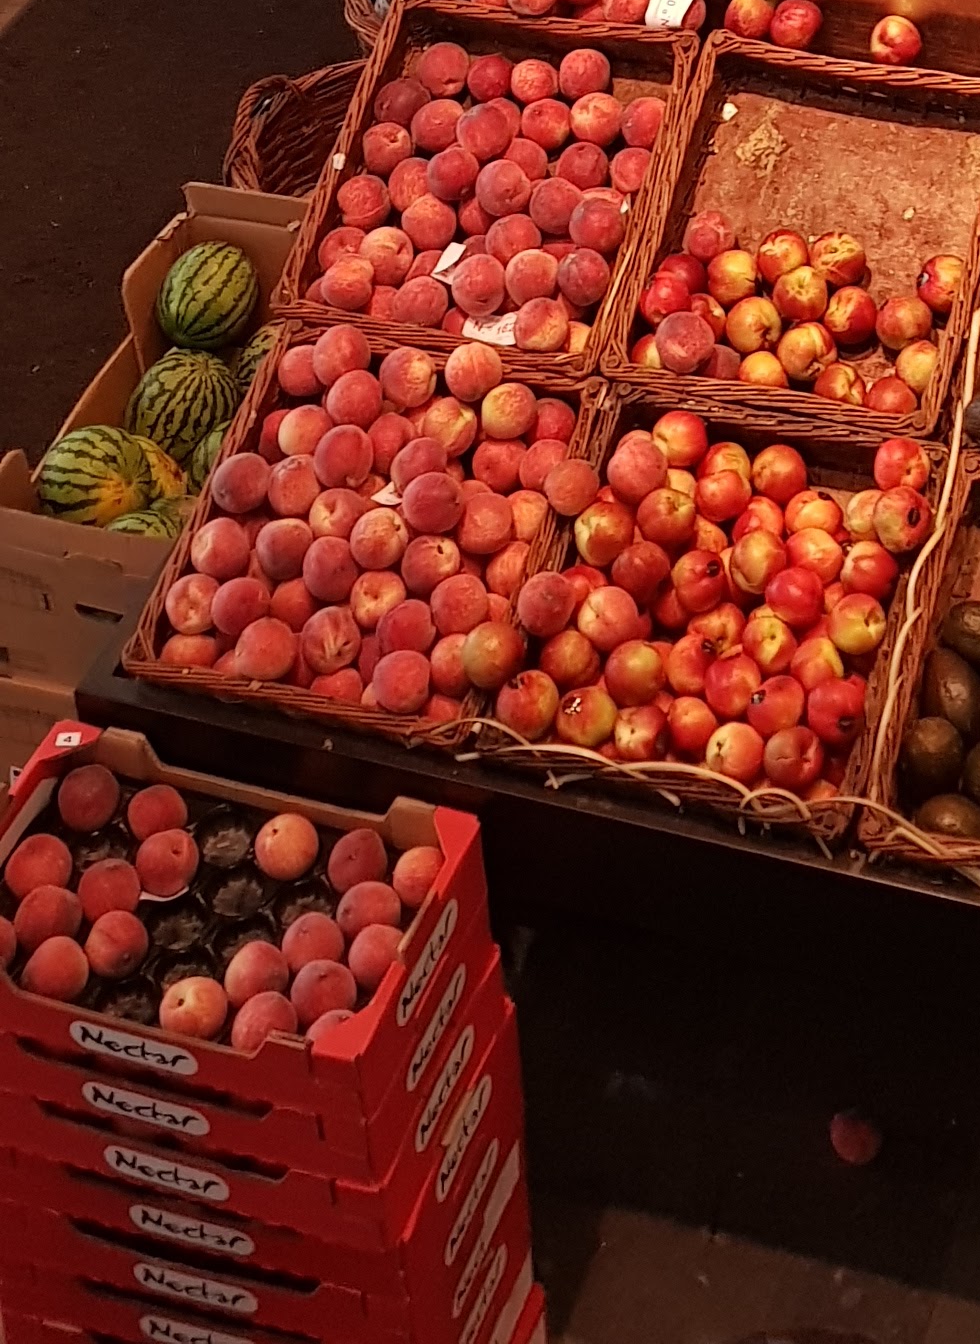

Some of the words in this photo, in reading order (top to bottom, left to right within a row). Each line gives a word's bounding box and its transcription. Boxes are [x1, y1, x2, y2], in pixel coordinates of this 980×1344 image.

[63, 735, 72, 743] 4
[80, 1024, 188, 1068] Nectar
[91, 1085, 200, 1128] Nectar
[114, 1149, 220, 1194] Nectar
[140, 1208, 246, 1249] Nectar
[142, 1266, 247, 1307] Nectar
